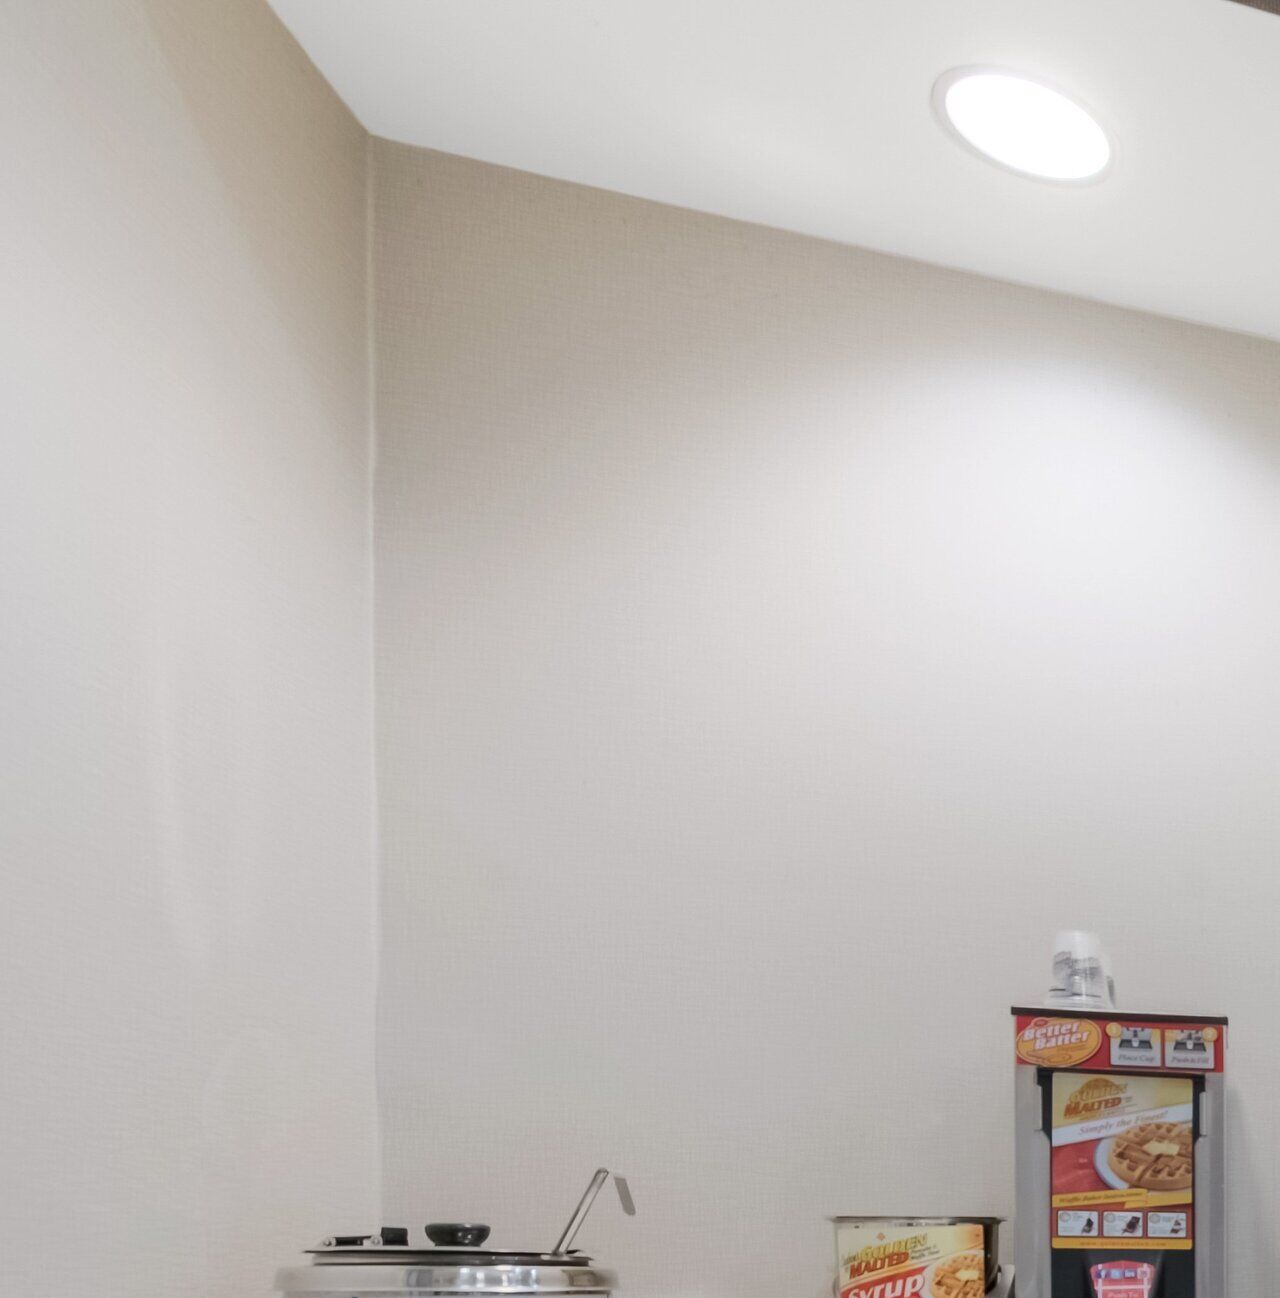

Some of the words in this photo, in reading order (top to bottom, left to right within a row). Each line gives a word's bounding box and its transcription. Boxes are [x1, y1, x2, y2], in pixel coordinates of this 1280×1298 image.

[1022, 1022, 1080, 1042] Better
[1033, 1031, 1090, 1051] Batter
[1063, 1097, 1122, 1117] MALTED
[1078, 1121, 1113, 1135] Simply
[1116, 1117, 1133, 1125] the
[849, 1251, 910, 1279] MALTED
